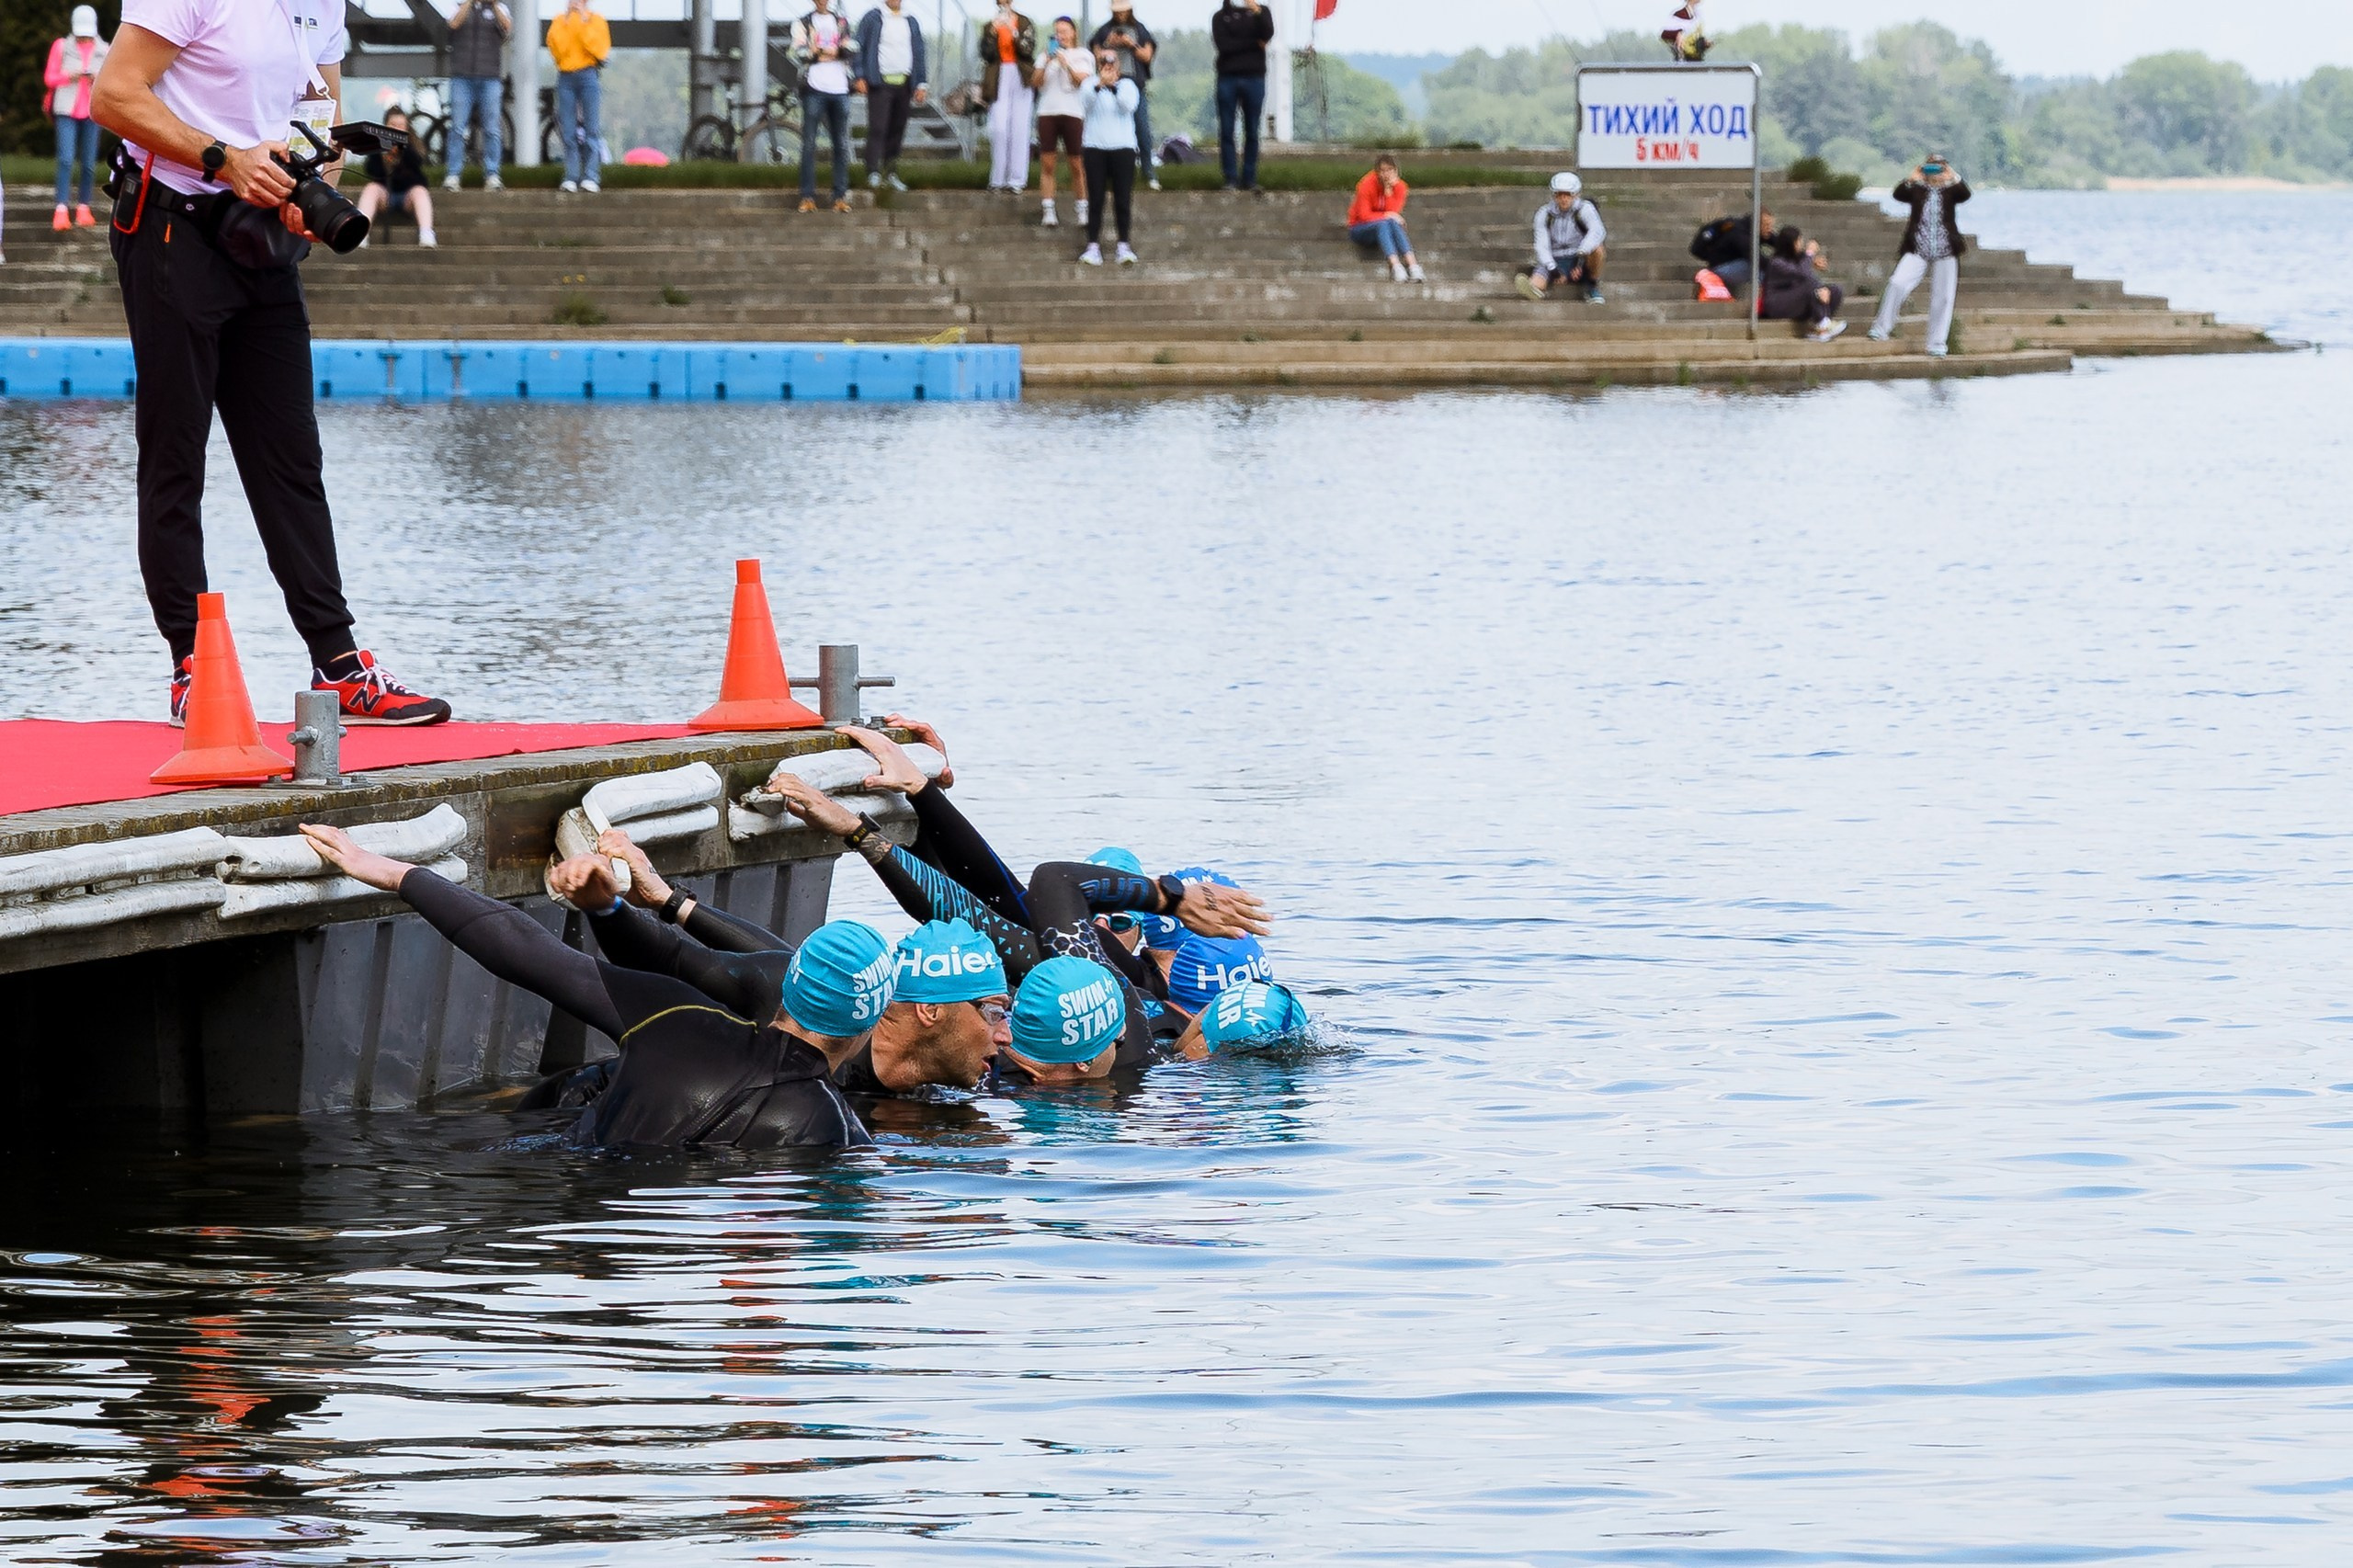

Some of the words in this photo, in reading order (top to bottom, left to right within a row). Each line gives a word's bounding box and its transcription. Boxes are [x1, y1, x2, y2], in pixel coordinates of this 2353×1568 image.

[1588, 97, 1678, 135] ТИХИЙ
[1690, 105, 1747, 140] ХОД
[1636, 137, 1646, 161] 5
[1058, 980, 1108, 1018] SWIM
[1061, 997, 1120, 1046] STAR
